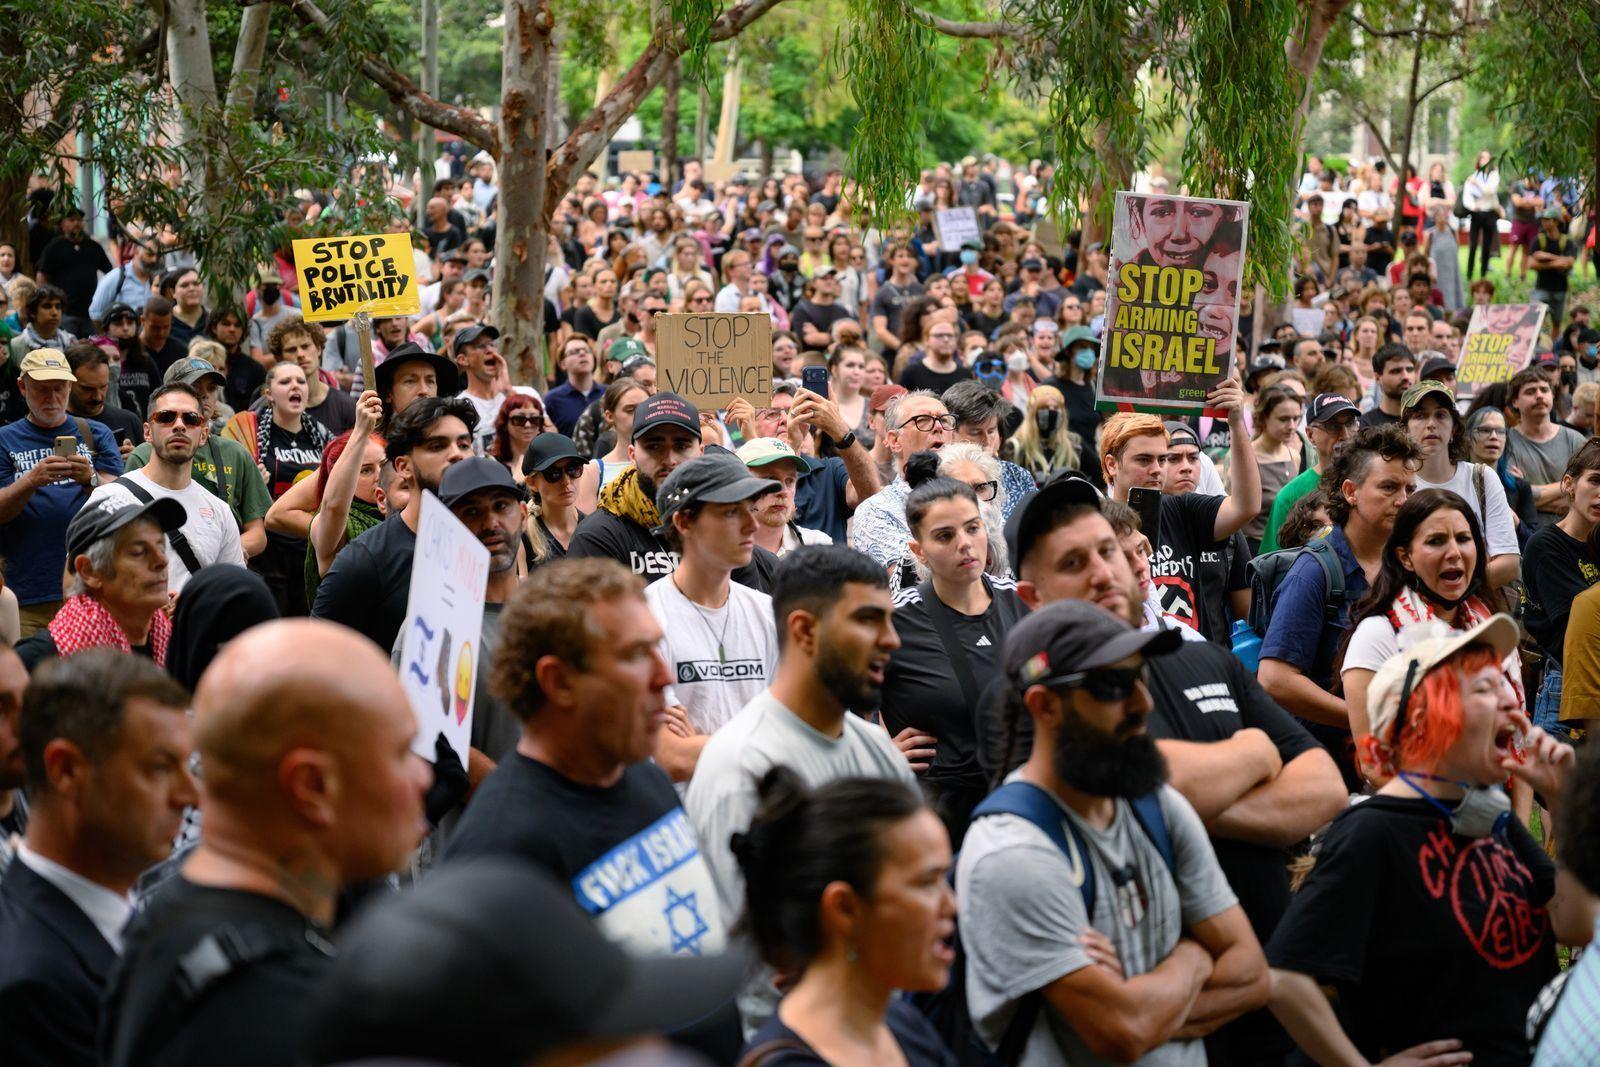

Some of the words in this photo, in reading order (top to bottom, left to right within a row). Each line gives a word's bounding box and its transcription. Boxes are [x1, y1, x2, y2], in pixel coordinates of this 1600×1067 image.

[312, 238, 386, 264] STOP
[304, 257, 398, 289] POLICE
[1118, 262, 1204, 307] STOP
[309, 274, 409, 313] BRUTALITY
[684, 315, 750, 349] STOP
[1114, 305, 1199, 334] ARMING
[1110, 331, 1220, 375] ISRAEL
[1466, 333, 1514, 353] STOP
[696, 350, 724, 365] THE
[1463, 352, 1507, 365] ARMING
[665, 365, 770, 395] VIOLENCE
[1179, 388, 1206, 398] green
[39, 447, 55, 458] FO
[629, 551, 681, 575] DEST
[1148, 544, 1173, 563] EAD
[1152, 555, 1194, 579] NEDYS
